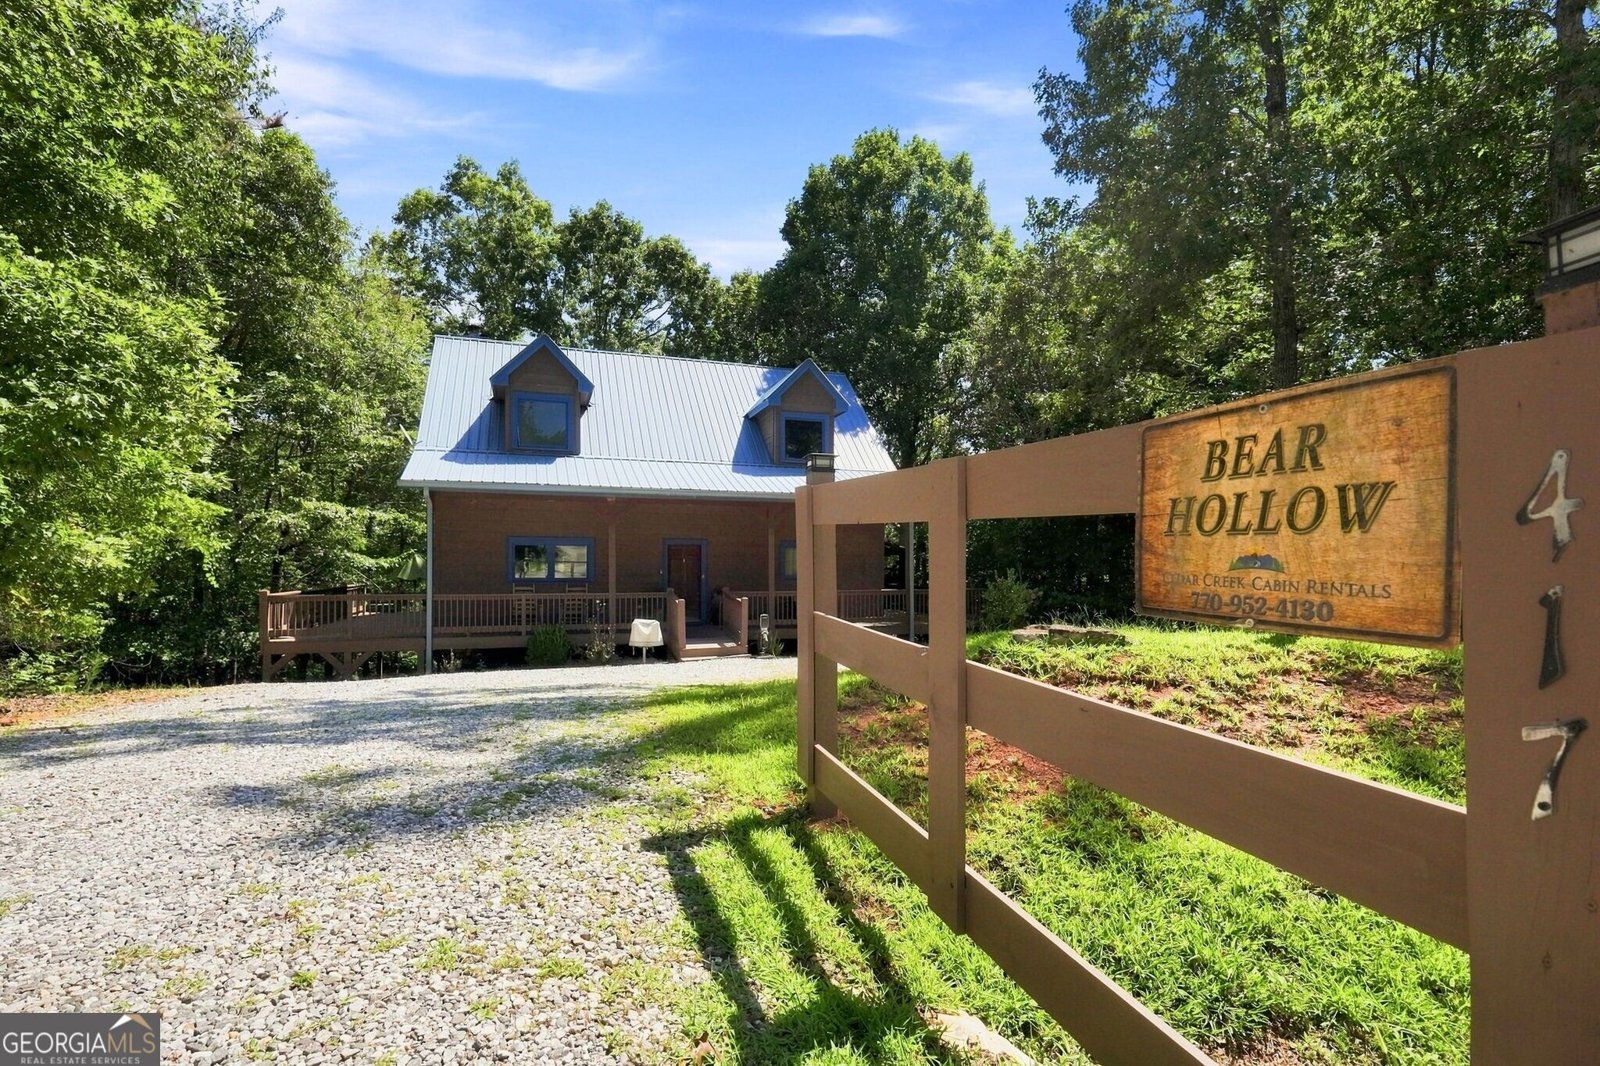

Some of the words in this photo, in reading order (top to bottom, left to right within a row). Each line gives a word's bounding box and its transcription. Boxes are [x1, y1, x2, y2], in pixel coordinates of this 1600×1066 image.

[1201, 423, 1327, 482] BEAR
[1165, 481, 1396, 536] HOLLOW
[1191, 592, 1333, 621] 770-952-4130
[1202, 573, 1246, 589] CREEK
[1251, 576, 1300, 593] CABIN
[1306, 579, 1392, 599] RENTALS
